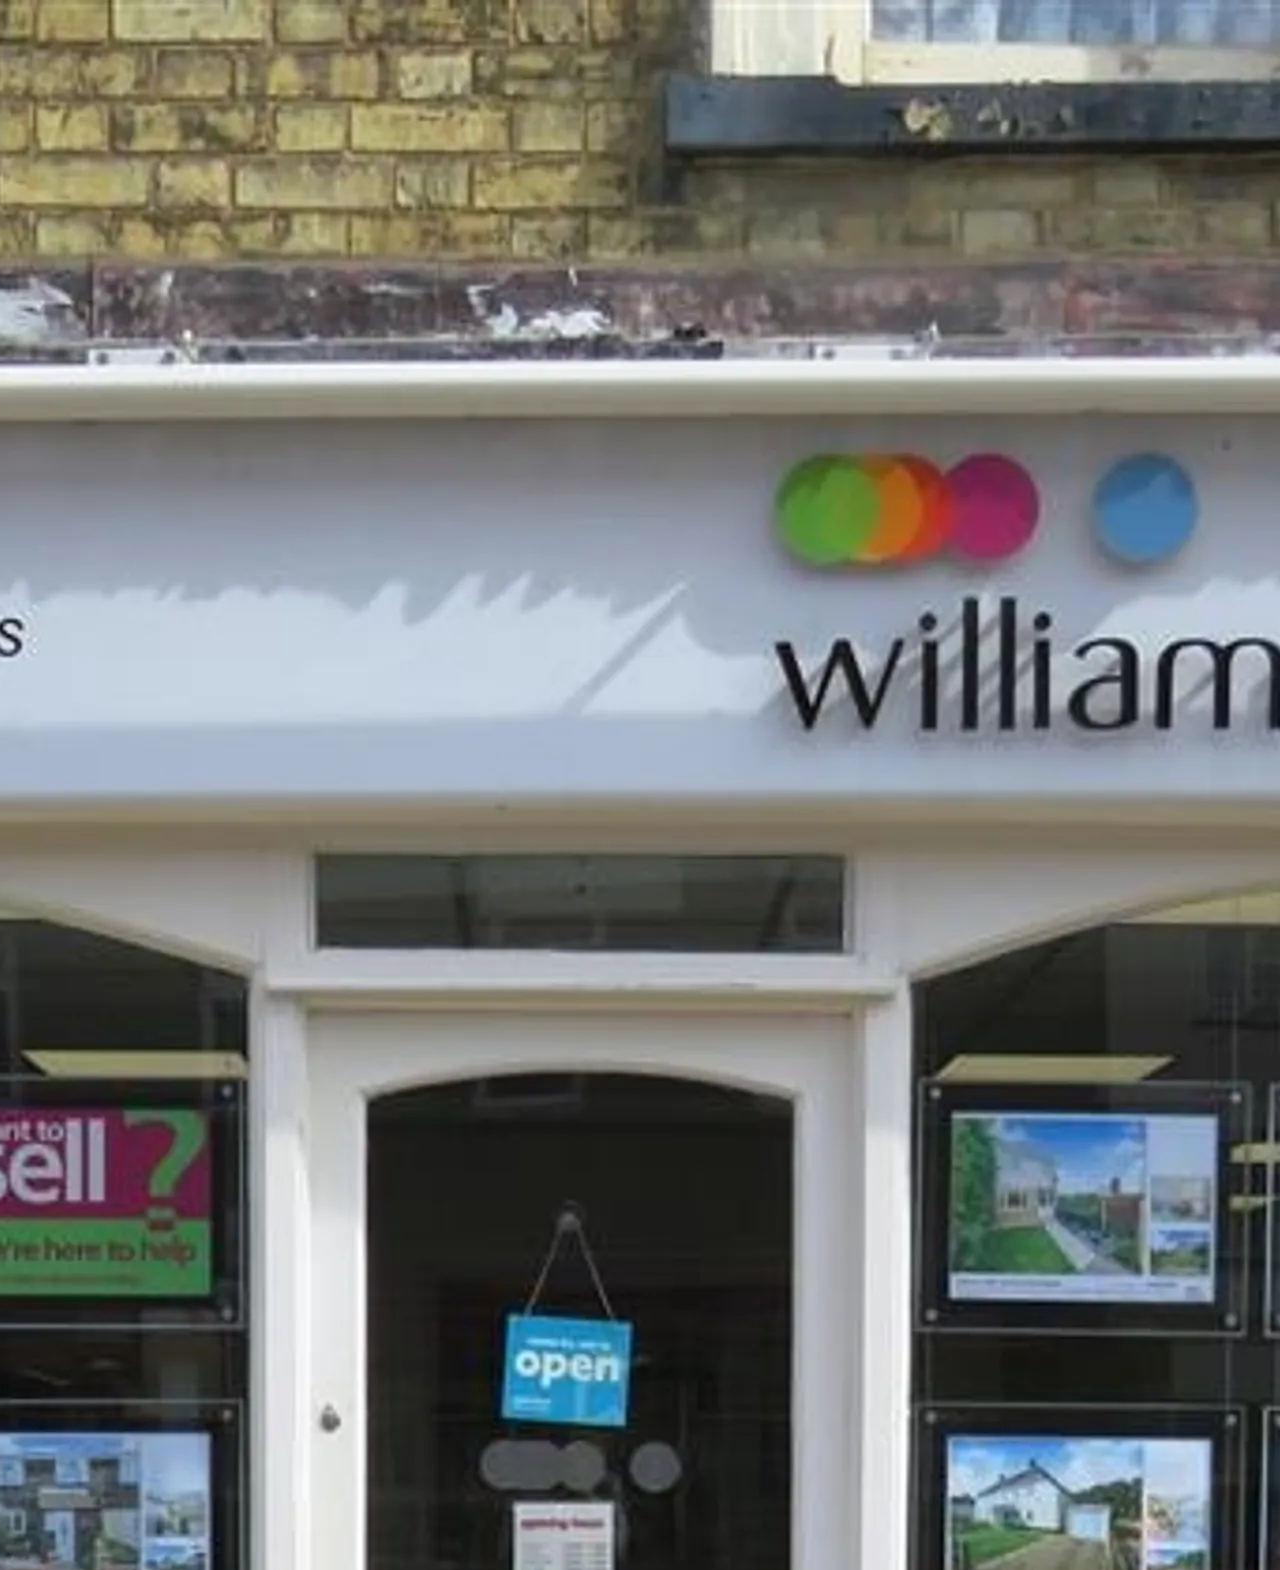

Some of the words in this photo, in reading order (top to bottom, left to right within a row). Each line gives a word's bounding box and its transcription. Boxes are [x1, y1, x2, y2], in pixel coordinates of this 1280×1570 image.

[37, 1120, 65, 1142] to
[42, 1233, 101, 1262] here
[106, 1236, 136, 1262] to
[514, 1350, 621, 1390] open
